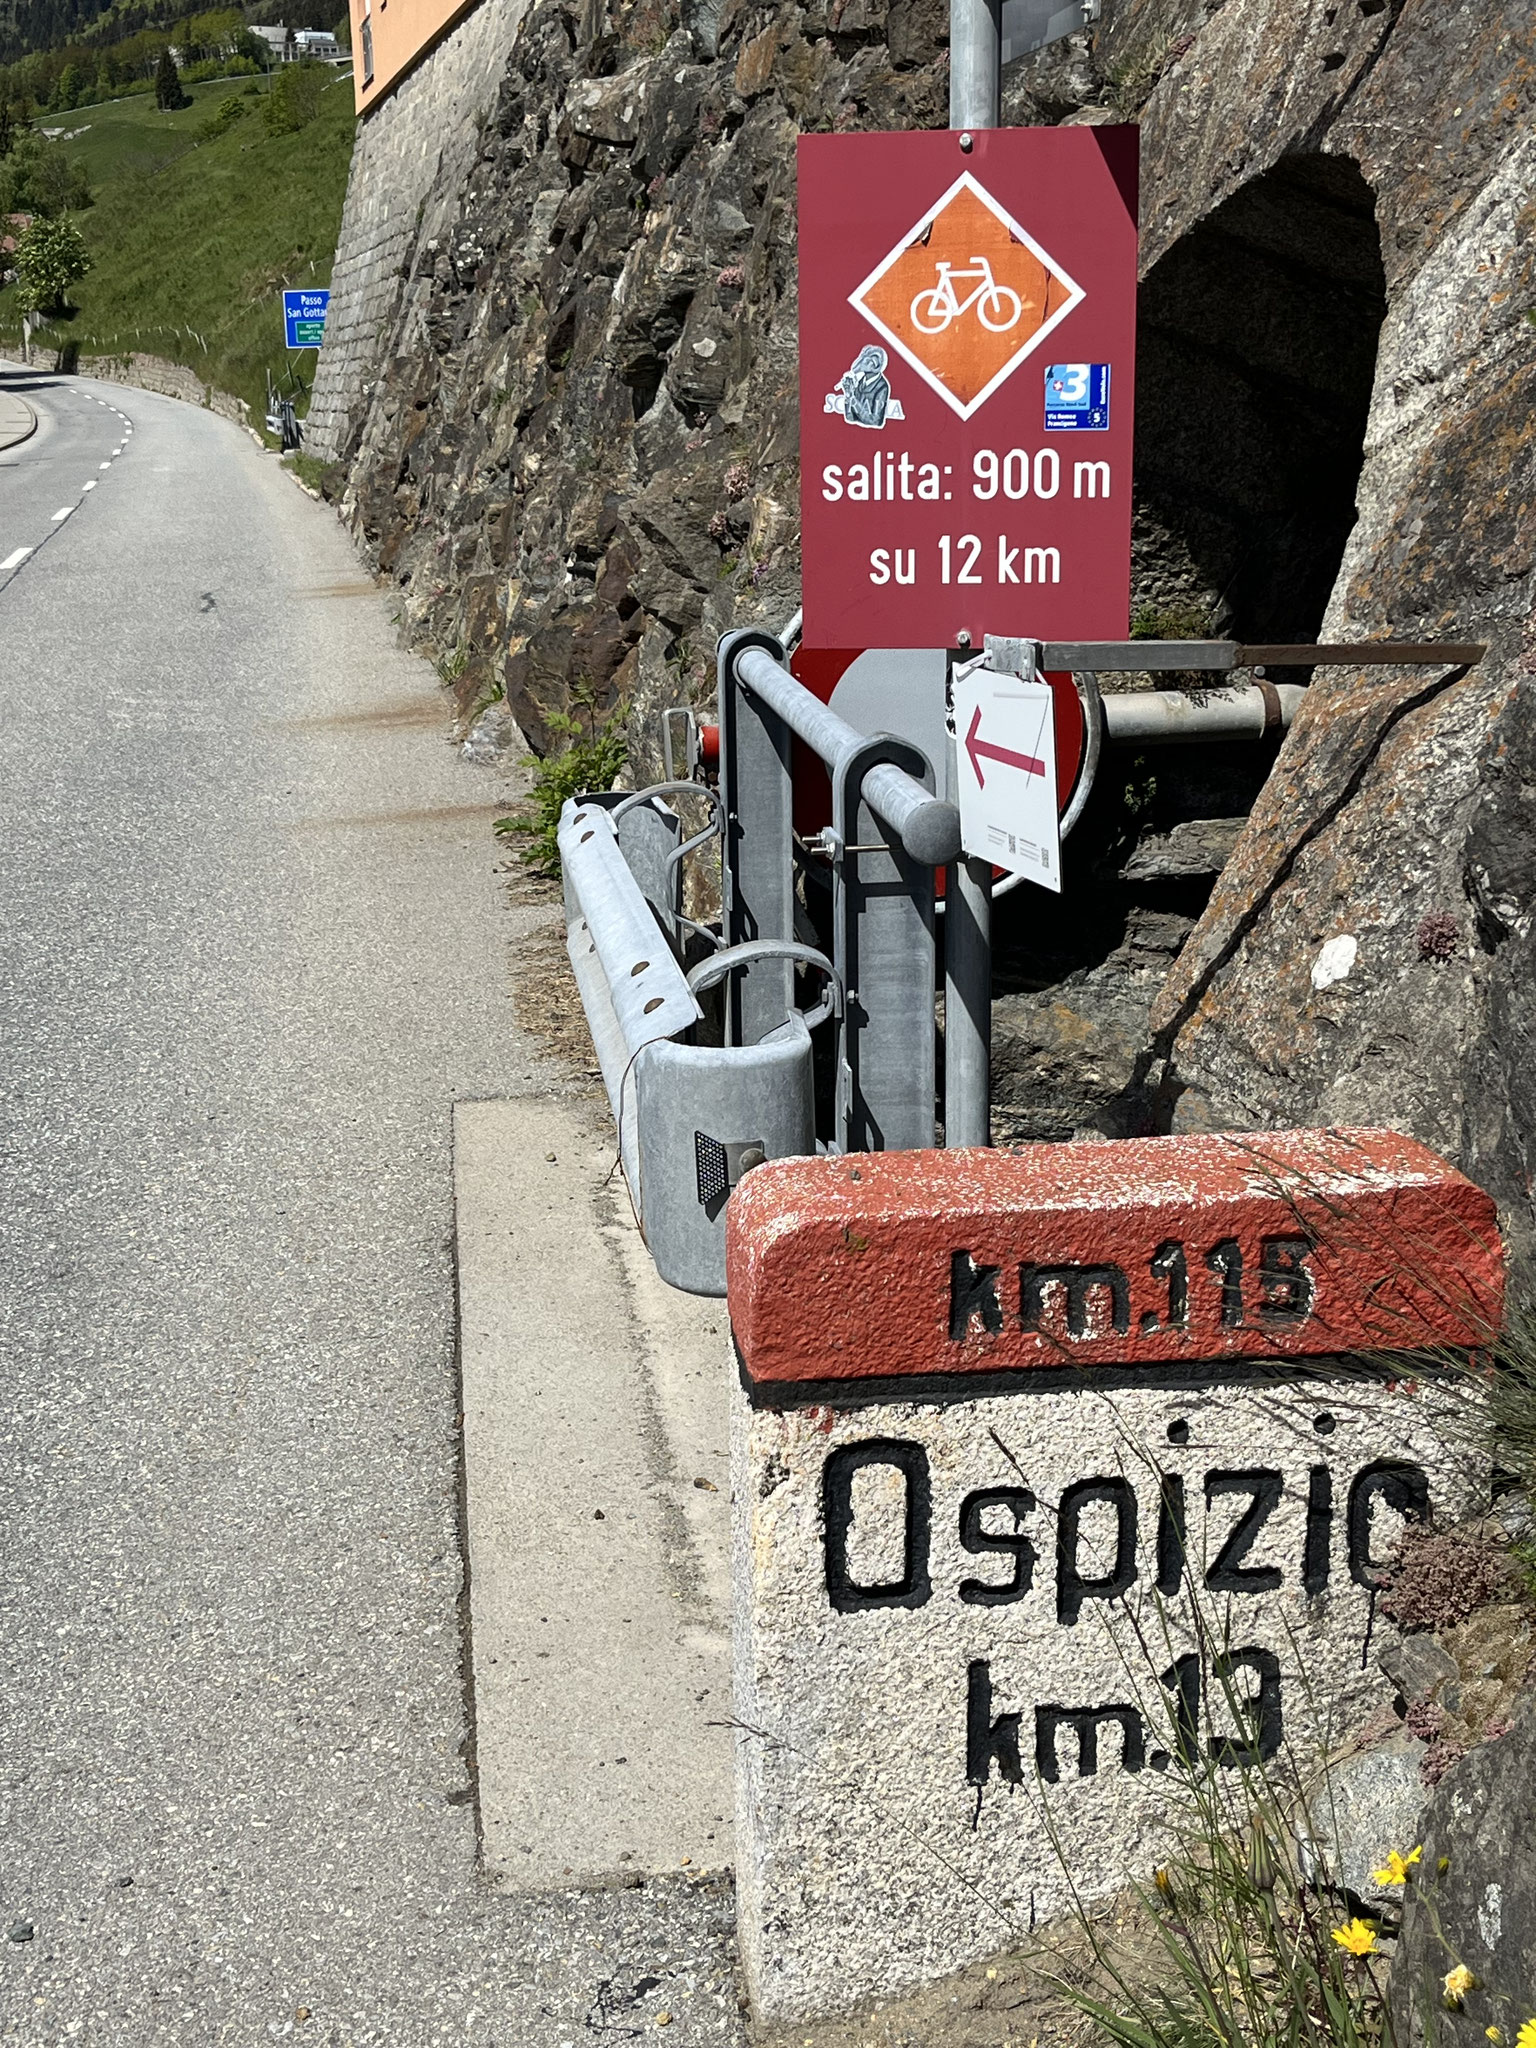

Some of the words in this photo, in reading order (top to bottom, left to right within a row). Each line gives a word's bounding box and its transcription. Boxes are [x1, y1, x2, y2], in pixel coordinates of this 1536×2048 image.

[287, 308, 301, 318] San
[301, 295, 322, 305] Passo
[1059, 363, 1090, 402] 3
[1093, 412, 1101, 423] 5
[822, 451, 953, 501] salita:
[972, 448, 1060, 500] 900
[1073, 460, 1111, 499] m
[869, 547, 915, 586] su
[938, 535, 982, 585] 12
[998, 535, 1060, 584] km
[823, 1418, 1430, 1626] Ospizio
